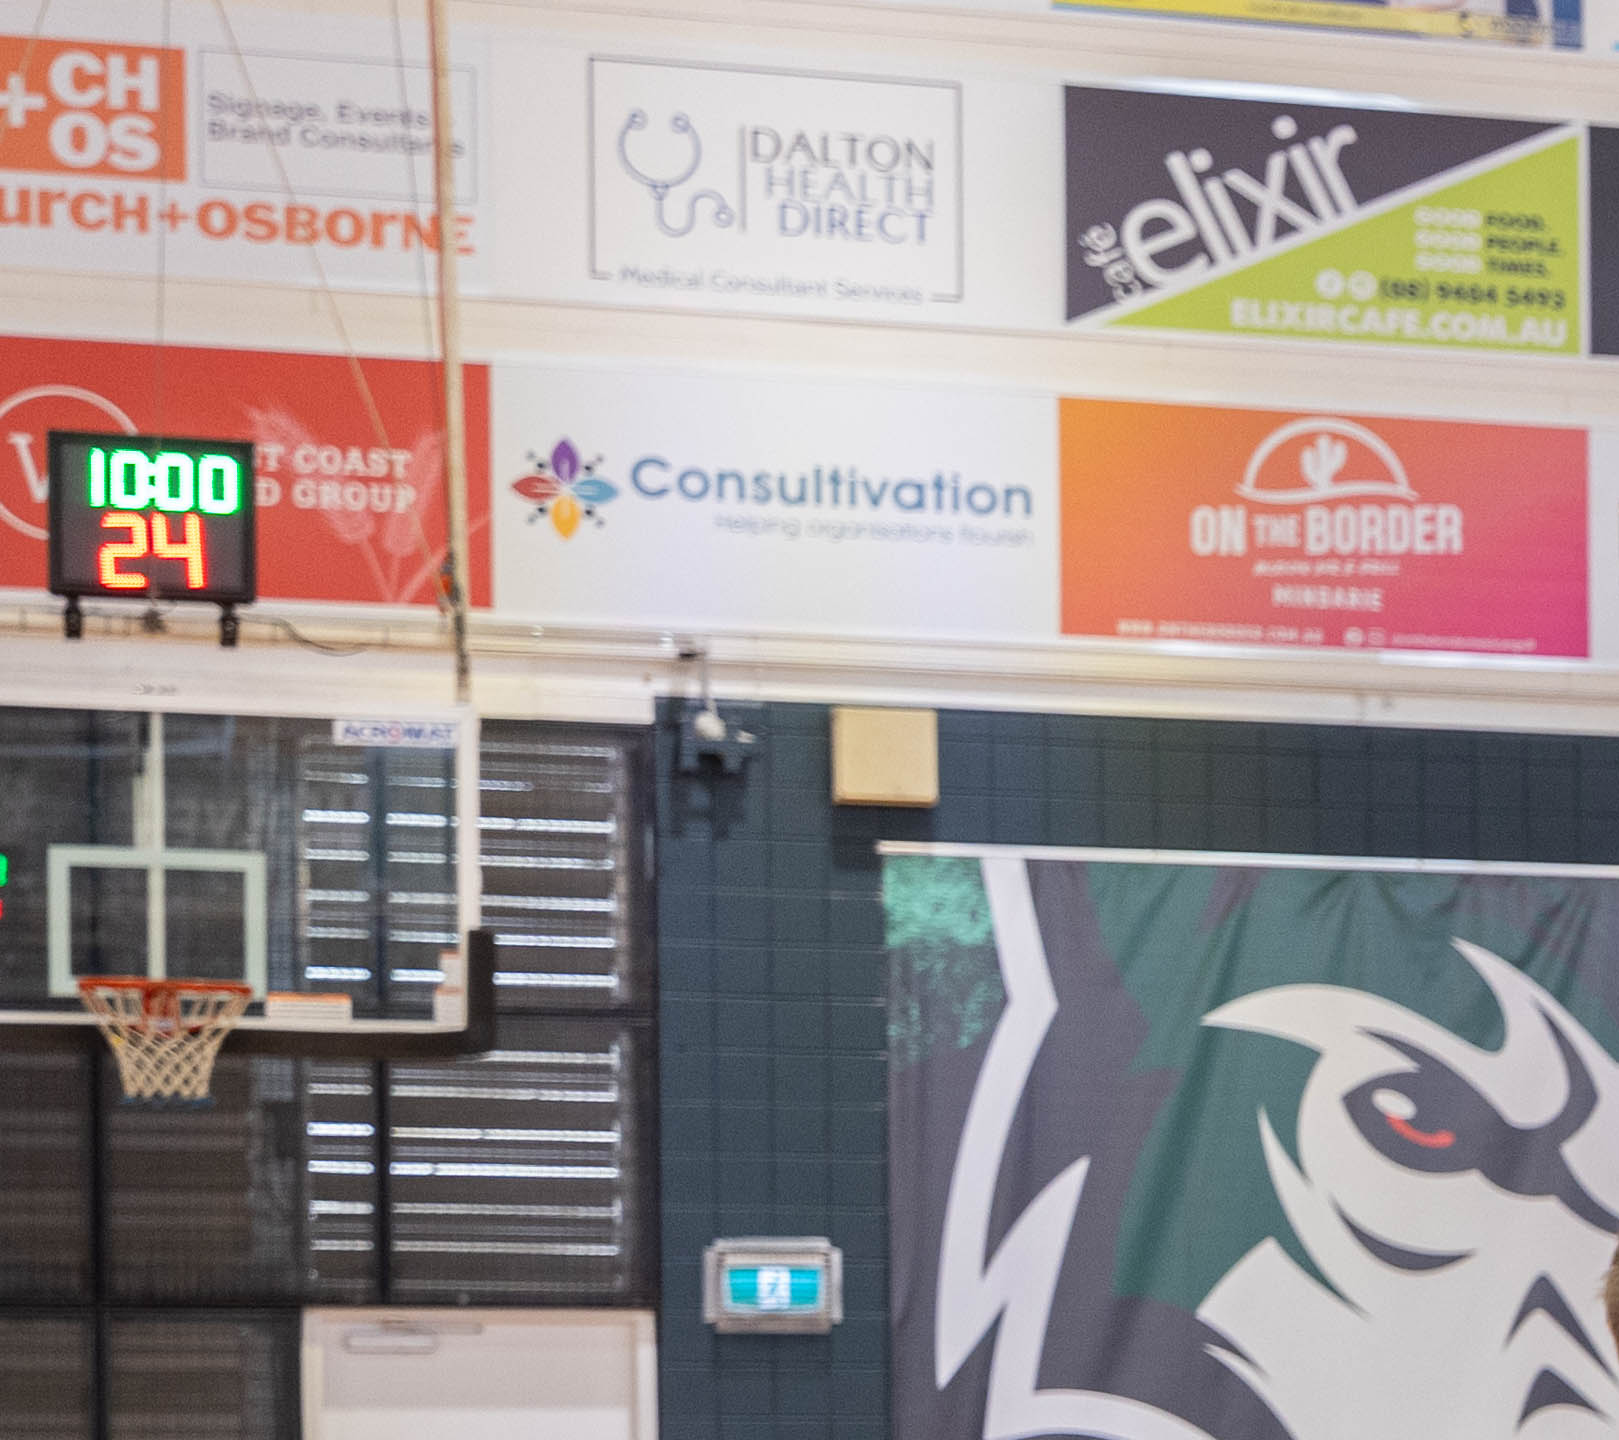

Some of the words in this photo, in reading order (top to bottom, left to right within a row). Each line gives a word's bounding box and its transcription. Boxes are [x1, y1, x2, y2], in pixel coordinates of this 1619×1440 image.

[49, 50, 160, 111] CH
[49, 111, 162, 172] OS
[301, 127, 465, 159] Consultans
[751, 125, 935, 174] DALTON
[764, 165, 935, 210] HEALTH
[1121, 114, 1359, 288] elixir
[778, 200, 934, 245] DIRECT
[619, 265, 704, 289] Medical
[711, 270, 827, 298] Consultant
[836, 280, 924, 303] Services
[1230, 300, 1567, 347] ELIXIRCAFE.COM.AU
[88, 446, 243, 516] 10:00
[292, 443, 413, 481] COAST
[630, 455, 1034, 518] Consultivation
[292, 481, 418, 515] GROUP
[97, 511, 208, 591] 24
[1189, 504, 1247, 557] ON
[1252, 513, 1300, 549] THE
[1305, 504, 1465, 556] BORDER
